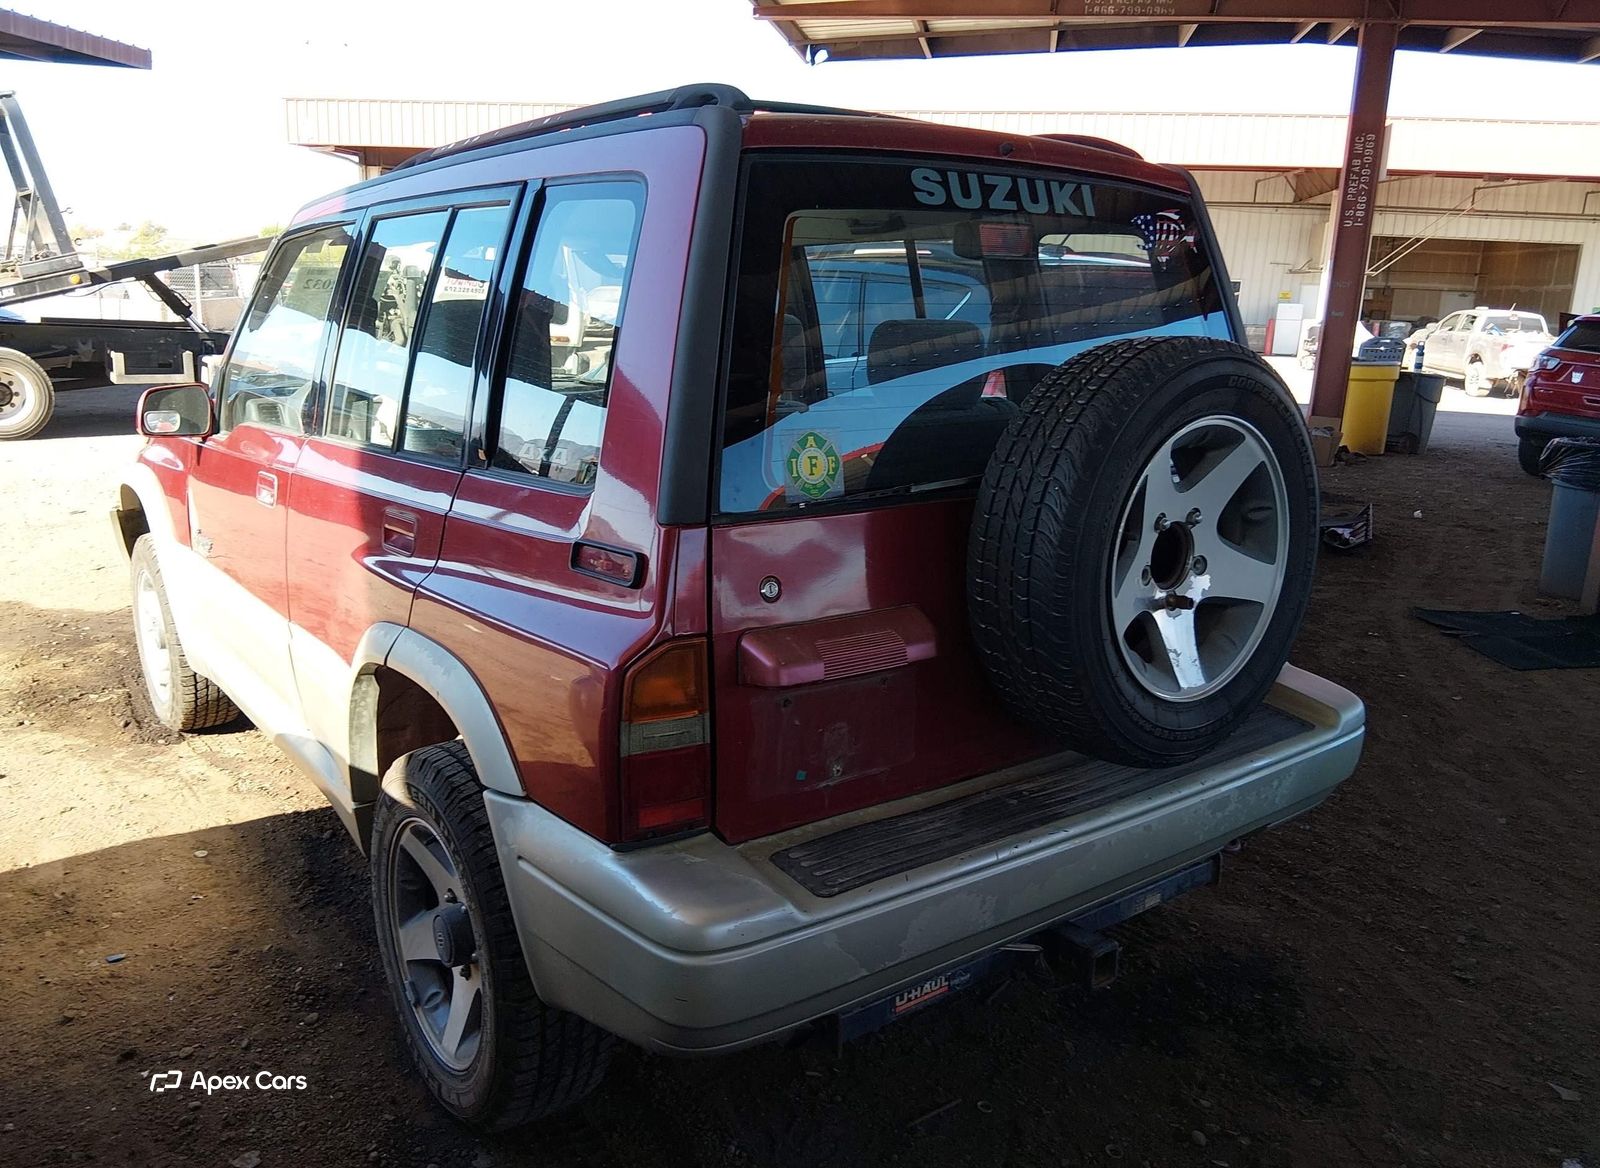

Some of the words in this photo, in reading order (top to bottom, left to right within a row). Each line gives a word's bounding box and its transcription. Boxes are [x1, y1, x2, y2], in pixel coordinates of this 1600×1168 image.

[1353, 132, 1366, 154] INC.
[910, 167, 1096, 217] SUZUKI
[1346, 158, 1362, 201] PREFAB
[1354, 133, 1376, 226] 1-866-799-0969
[805, 436, 818, 448] A
[807, 455, 818, 476] F
[895, 975, 949, 1006] U-HAUL
